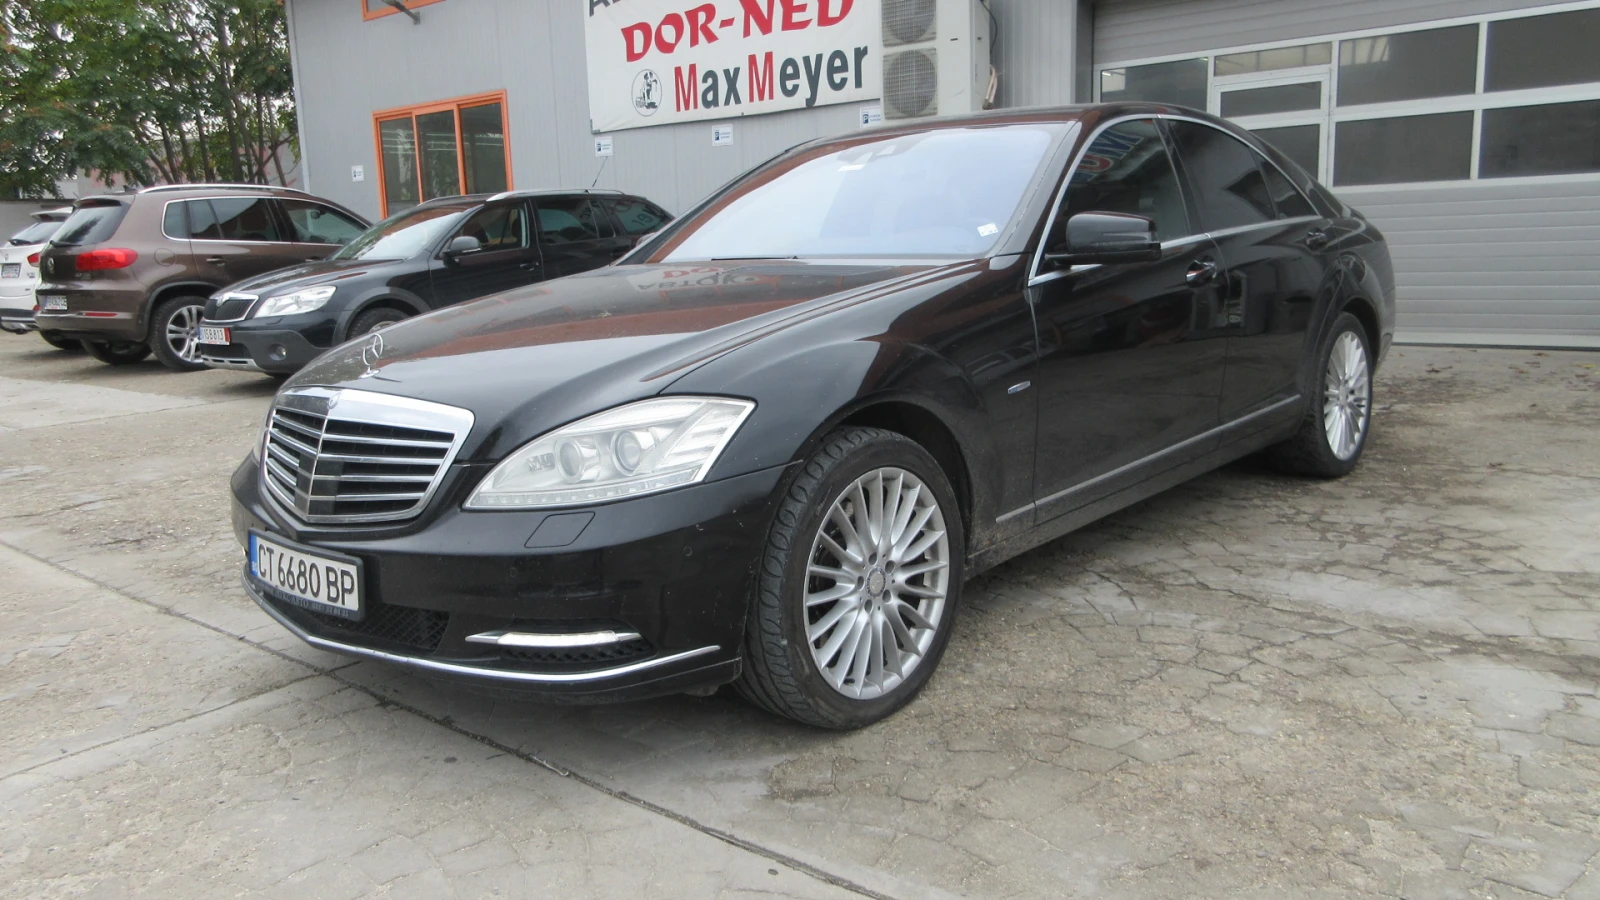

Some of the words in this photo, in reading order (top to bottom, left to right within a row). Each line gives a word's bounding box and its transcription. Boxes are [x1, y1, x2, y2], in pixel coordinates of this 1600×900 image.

[621, 0, 853, 62] DOR-NED
[674, 46, 868, 112] MaxMeyer
[258, 543, 275, 582] CT
[278, 552, 321, 598] 6680
[325, 565, 355, 606] BP
